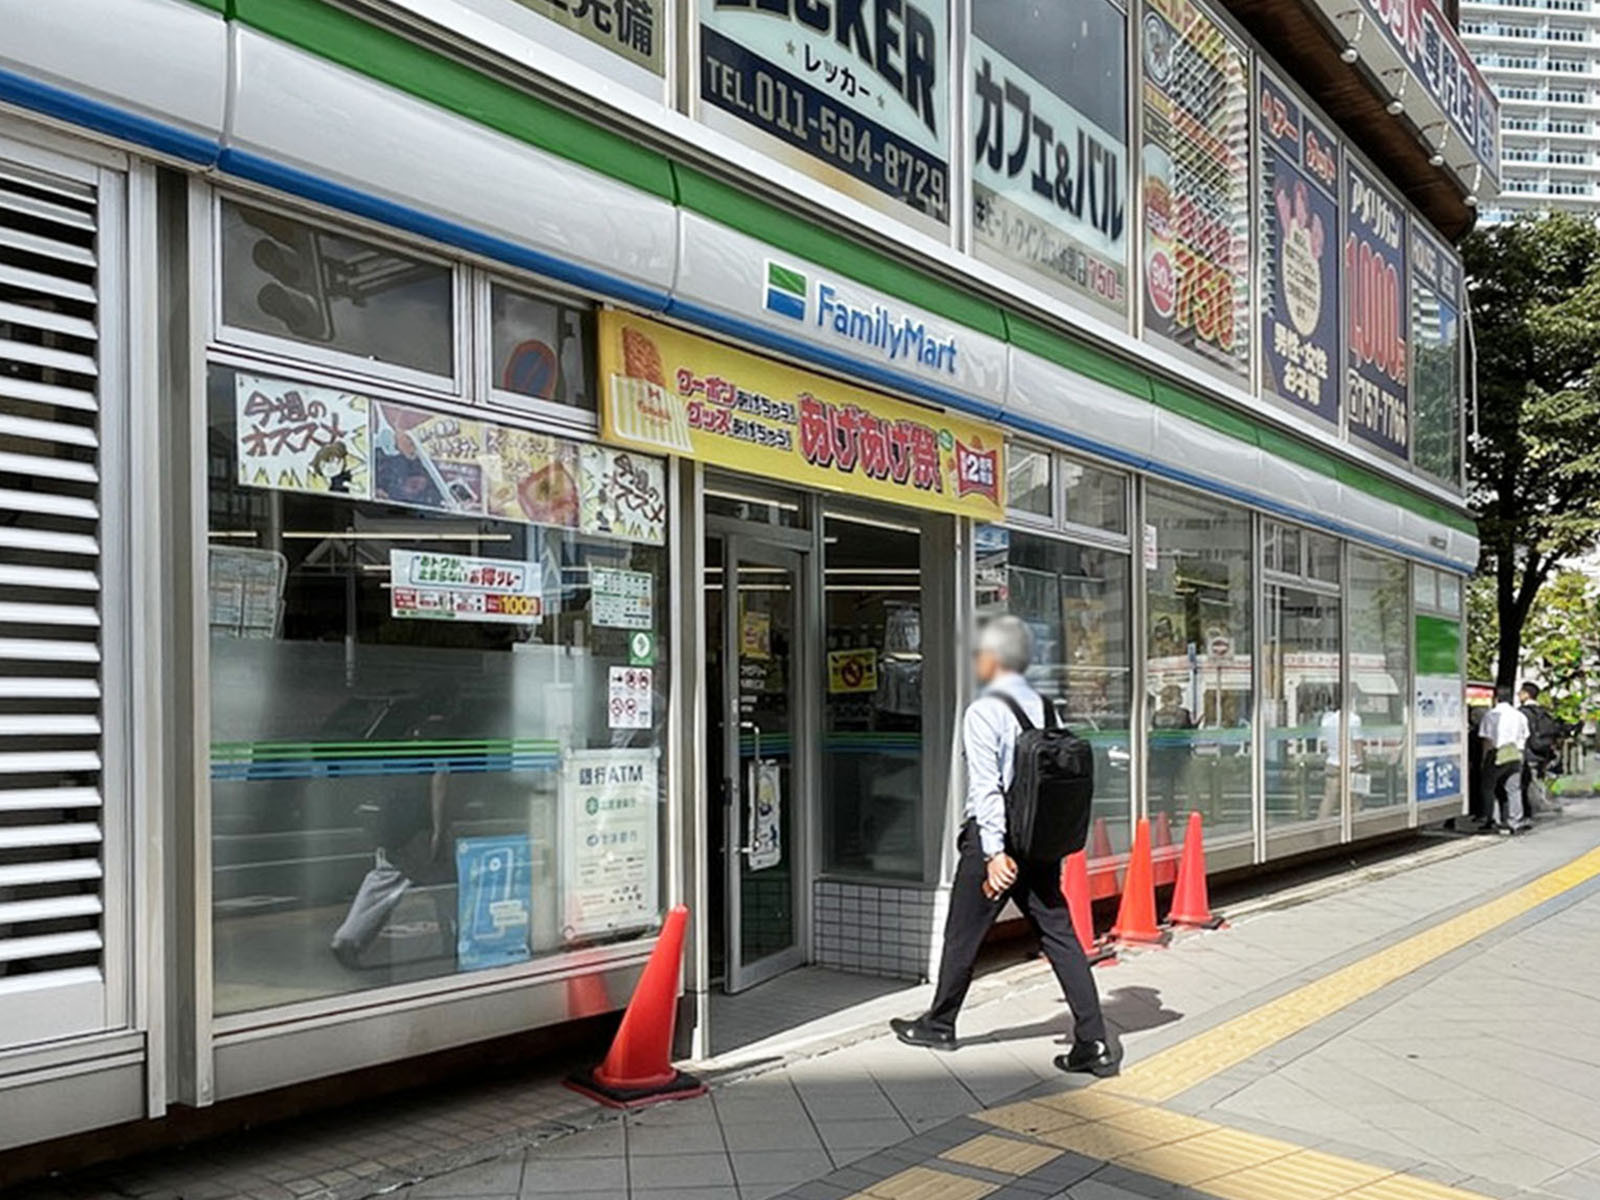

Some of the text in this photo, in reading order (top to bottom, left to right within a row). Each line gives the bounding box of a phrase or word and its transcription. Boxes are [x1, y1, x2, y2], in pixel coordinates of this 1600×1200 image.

[804, 43, 871, 98] レッカー
[975, 56, 1123, 242] カフェ&バル
[818, 283, 958, 374] FamilyMart
[241, 411, 347, 457] オススメ
[243, 389, 327, 425] 今週の
[798, 392, 943, 493] あげあげ祭
[579, 765, 643, 786] 銀行ATM
